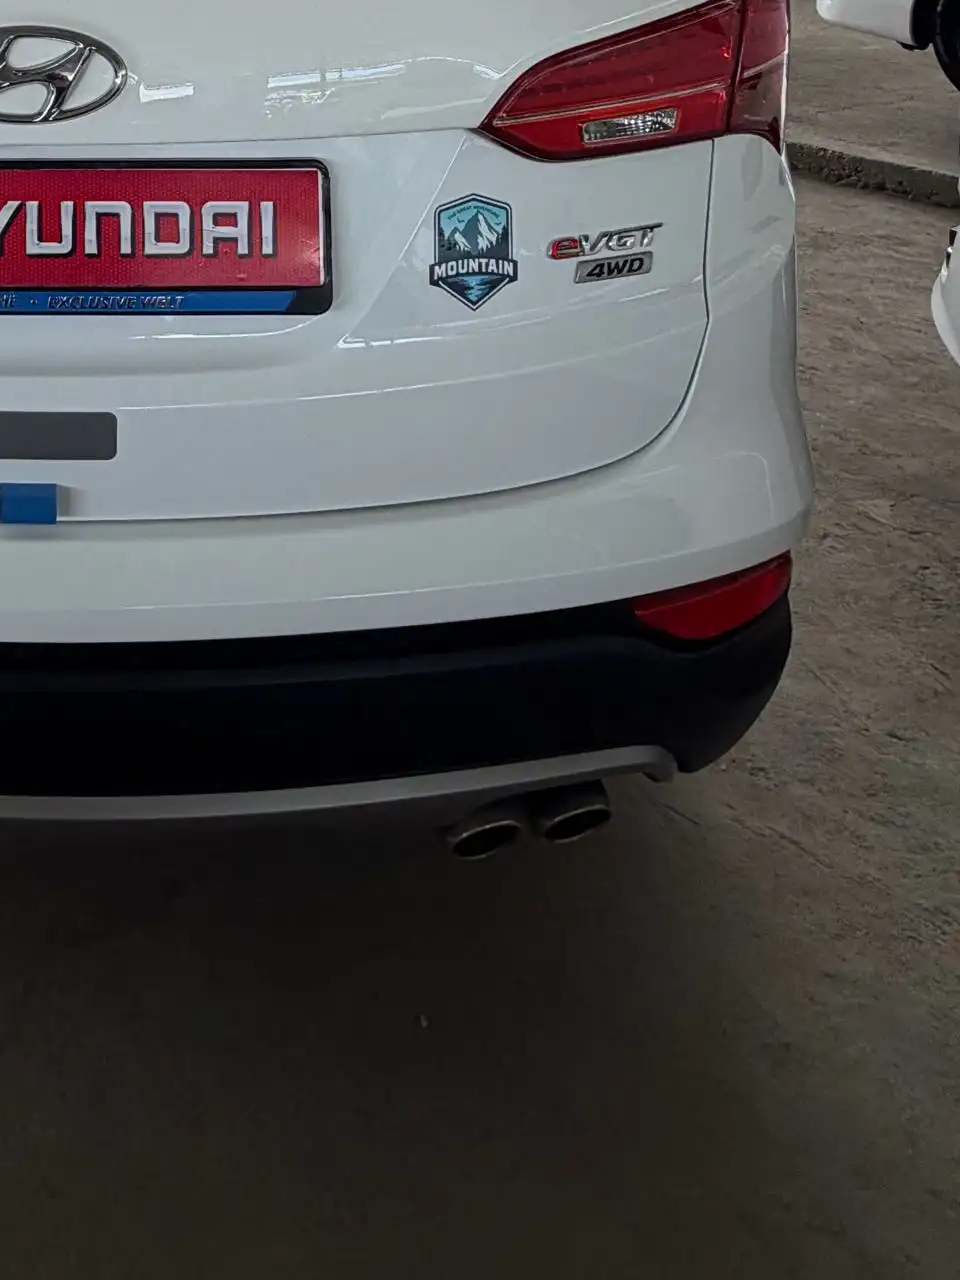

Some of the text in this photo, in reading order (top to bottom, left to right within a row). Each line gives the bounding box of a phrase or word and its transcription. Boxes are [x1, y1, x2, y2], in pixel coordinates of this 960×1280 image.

[433, 258, 514, 281] MOUNTAIN
[586, 257, 645, 278] 4WD
[47, 295, 137, 309] EXCLUSIVE
[141, 295, 185, 309] WELT
